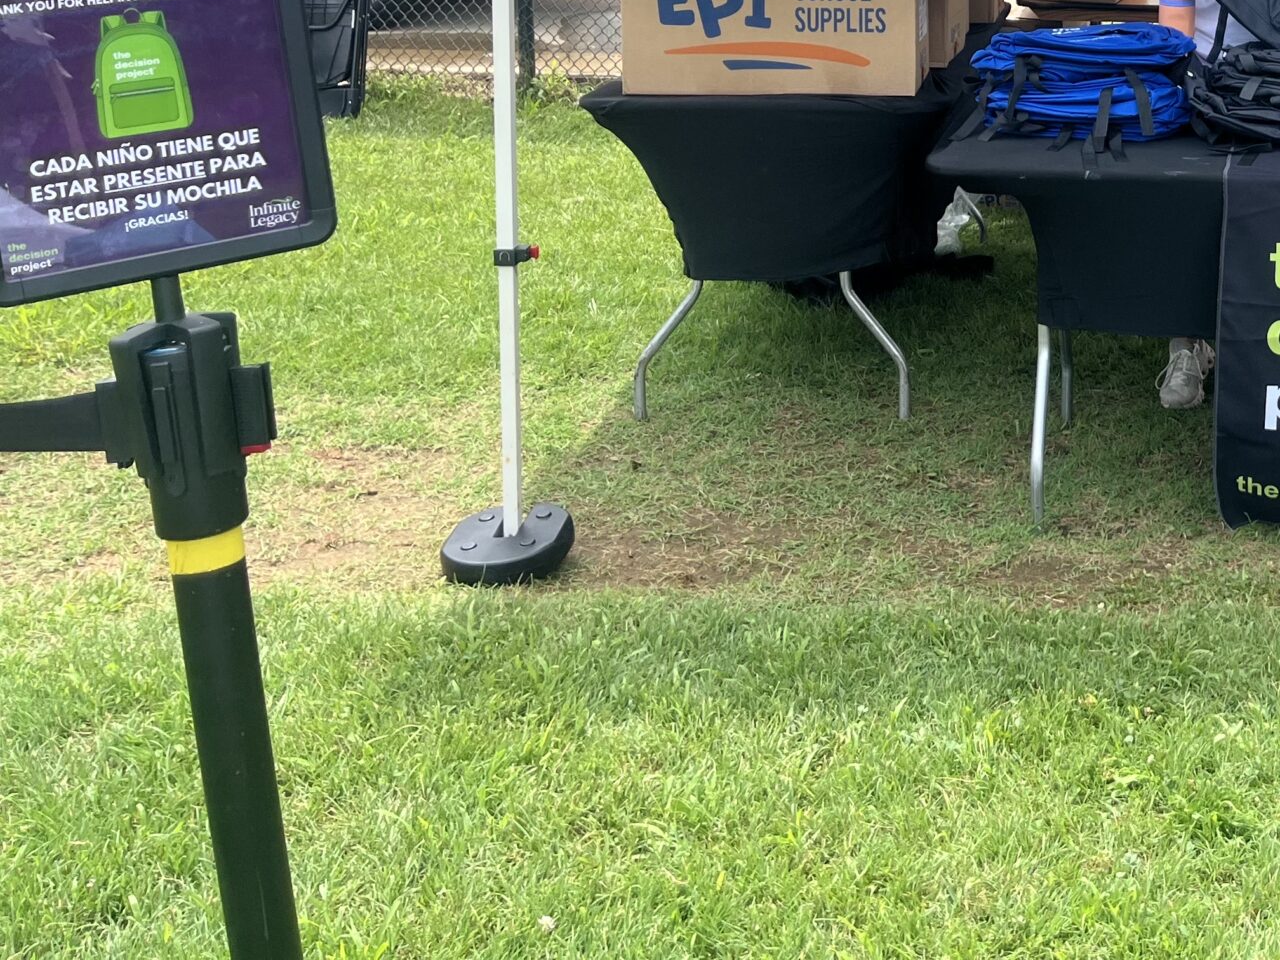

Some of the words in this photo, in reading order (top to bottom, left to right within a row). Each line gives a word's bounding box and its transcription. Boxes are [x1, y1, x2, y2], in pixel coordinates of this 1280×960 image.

[0, 2, 24, 16] ANK
[25, 0, 55, 13] YOU
[794, 6, 887, 34] SUPPLIES
[112, 51, 132, 60] the
[114, 57, 161, 70] decision
[115, 67, 156, 81] project
[29, 153, 93, 178] CADA
[96, 141, 153, 168] NIÑO
[157, 135, 215, 158] TIENE
[217, 127, 261, 149] QUE
[30, 180, 100, 203] ESTAR
[103, 161, 207, 192] PRESENTE
[208, 150, 267, 175] PARA
[47, 197, 130, 226] RECIBIR
[134, 191, 162, 211] SU
[166, 175, 263, 207] MOCHILA
[249, 198, 301, 218] Infinite
[124, 210, 190, 233] ¡GRACIAS!
[250, 210, 300, 228] Legacy
[7, 241, 27, 252] the
[8, 246, 60, 264] decision
[10, 257, 53, 276] project
